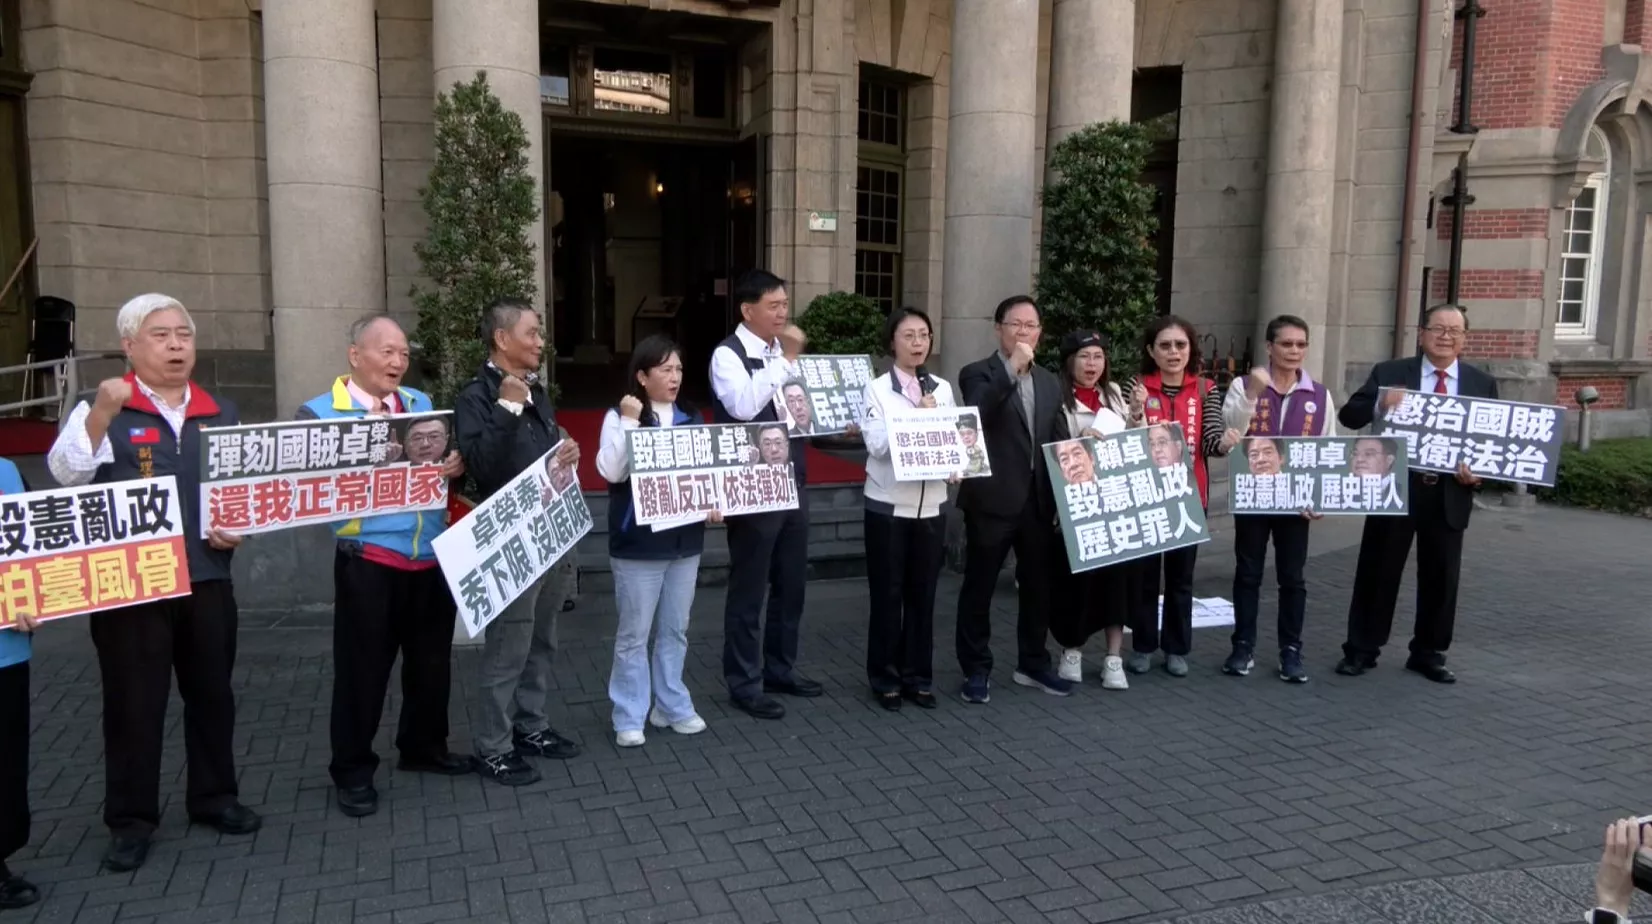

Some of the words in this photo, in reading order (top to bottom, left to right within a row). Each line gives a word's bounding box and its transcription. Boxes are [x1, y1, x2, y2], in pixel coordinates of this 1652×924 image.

[895, 430, 959, 447] 懲治國賊
[1384, 392, 1556, 443] 懲治國賊
[208, 421, 389, 479] 彈劾國賊卓榮泰
[631, 427, 714, 470] 毀憲國賊
[899, 449, 961, 468] 捍衛法治
[1094, 434, 1148, 471] 賴卓
[1288, 441, 1347, 469] 賴卓
[209, 460, 447, 530] 還我正常國家
[470, 474, 541, 550] 卓榮泰
[637, 472, 720, 518] 撥亂反正!
[1063, 462, 1193, 521] 毀憲亂政
[1234, 472, 1316, 510] 毀憲亂政
[1319, 472, 1404, 511] 歷史罪人
[458, 530, 534, 627] 秀下限
[527, 481, 591, 567] 沒底限
[1074, 501, 1203, 563] 歷史罪人
